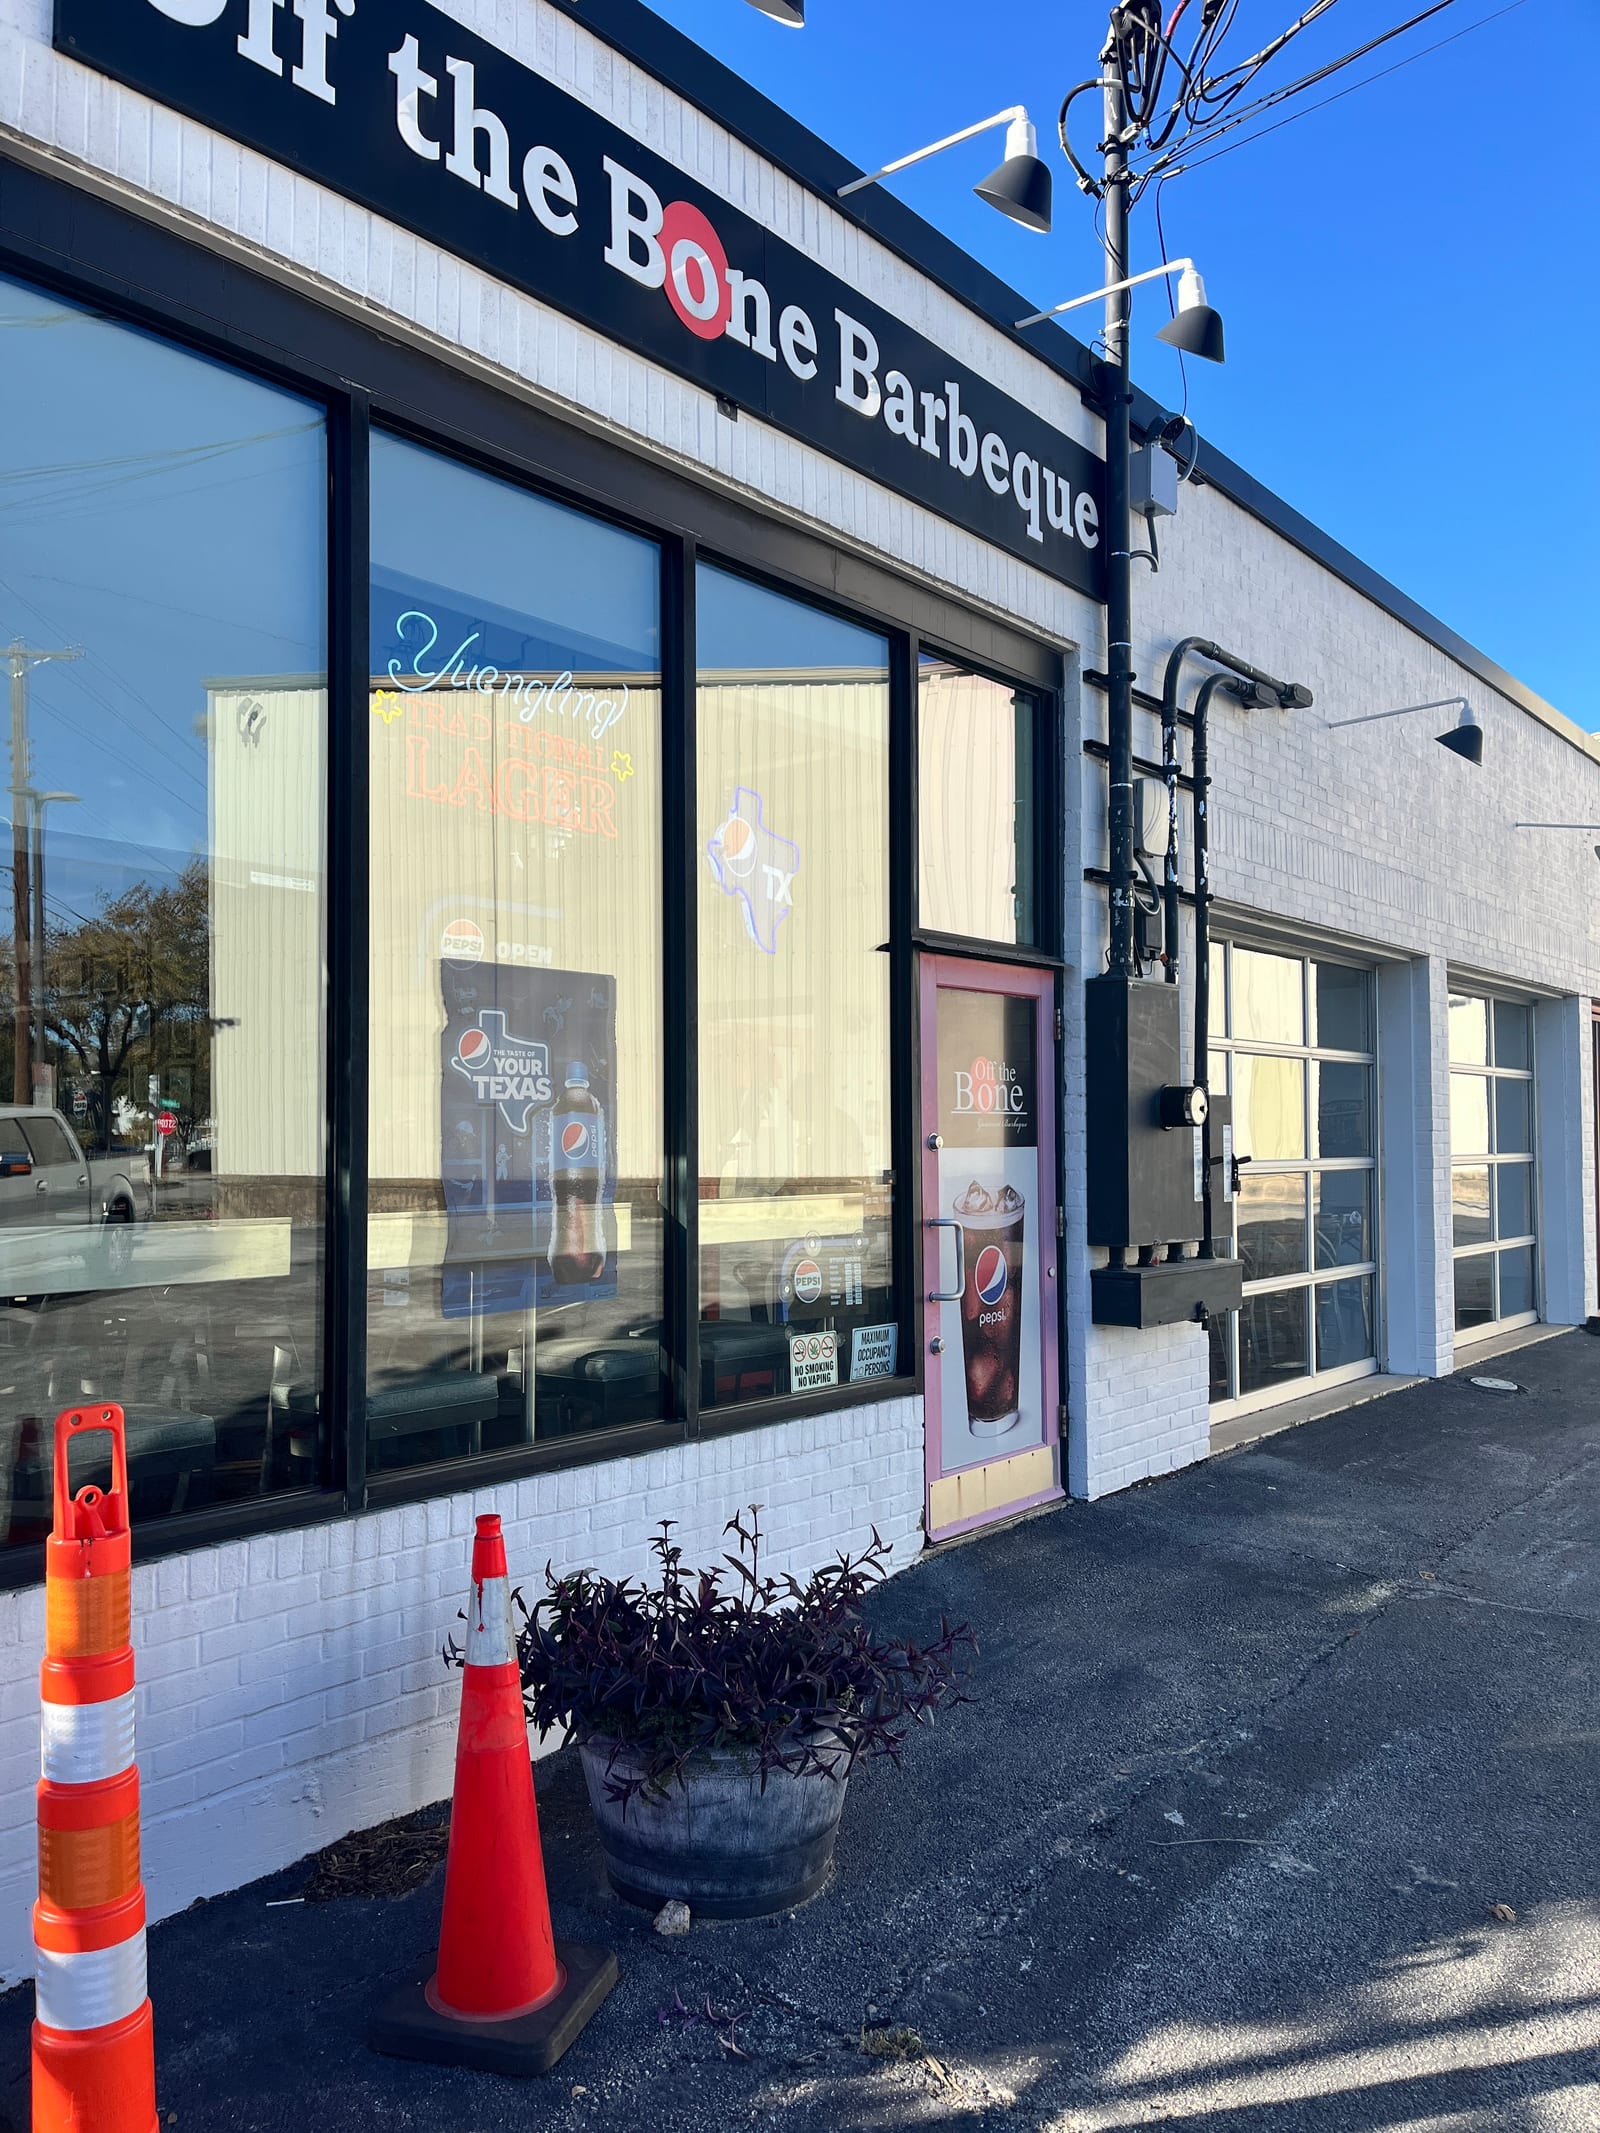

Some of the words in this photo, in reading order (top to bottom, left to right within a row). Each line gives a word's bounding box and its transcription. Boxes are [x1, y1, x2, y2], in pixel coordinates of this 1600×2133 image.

[147, 0, 356, 106] ff
[388, 33, 579, 237] the
[602, 154, 818, 381] Bone
[834, 307, 1100, 550] Barbeque
[388, 610, 629, 740] Yuengling
[403, 698, 609, 773] TRADTIONAL
[406, 734, 618, 838] LAGER
[762, 863, 794, 906] TX
[444, 937, 482, 953] PEPSI
[496, 941, 553, 965] OPEN
[507, 1049, 526, 1057] TASTE
[493, 1057, 543, 1075] YOUR
[975, 1060, 998, 1081] Off
[999, 1062, 1017, 1081] the
[472, 1075, 552, 1100] TEXAS
[953, 1071, 1024, 1111] Bone
[590, 1125, 598, 1158] pepsi
[795, 1274, 821, 1287] PEPSI
[979, 1308, 1005, 1328] pepsi
[861, 1329, 890, 1345] MAXIMUM
[857, 1344, 892, 1362] OCCUPANCY
[794, 1365, 804, 1377] NO
[805, 1360, 834, 1375] SMOKING
[864, 1360, 891, 1376] PERSONS
[798, 1376, 808, 1388] NO
[808, 1372, 832, 1386] VAPING
